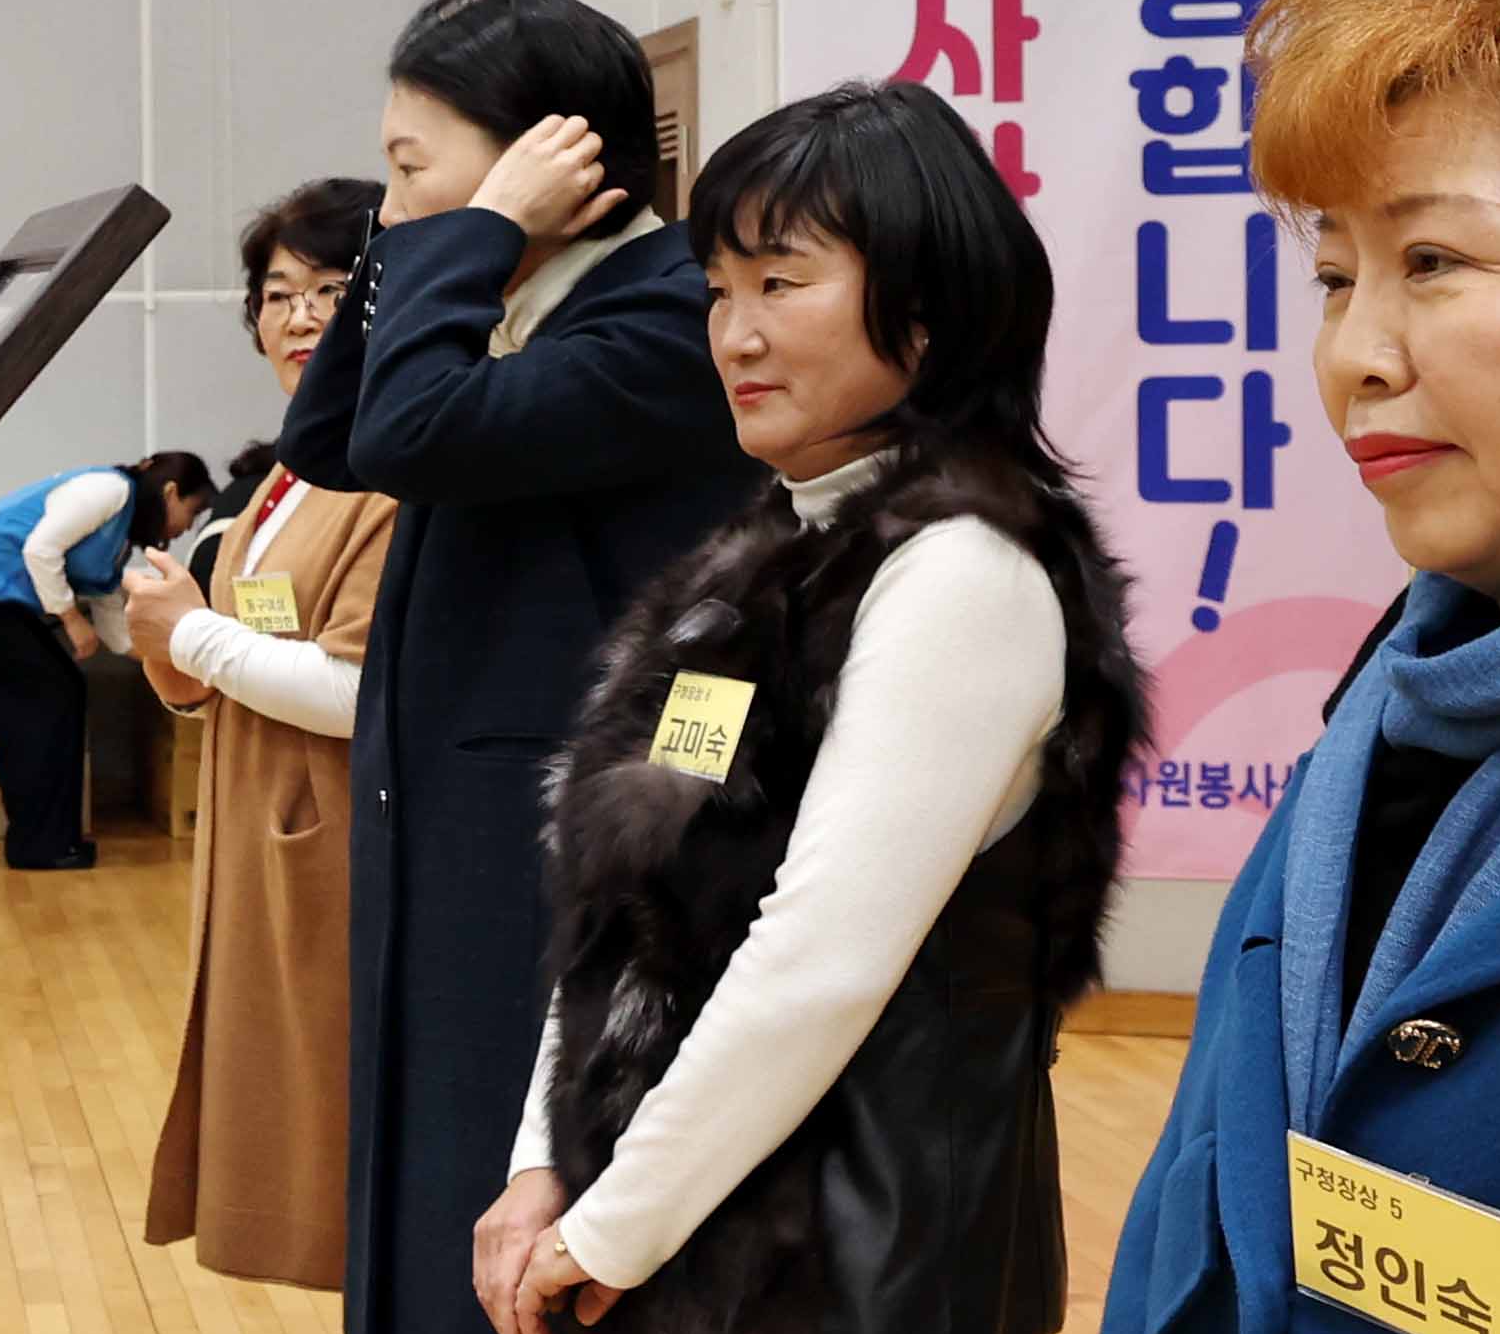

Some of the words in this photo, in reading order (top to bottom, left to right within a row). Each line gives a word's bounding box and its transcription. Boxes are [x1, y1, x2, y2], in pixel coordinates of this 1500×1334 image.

[660, 717, 728, 763] 고미숙
[1295, 1157, 1379, 1211] 구청장상
[1389, 1197, 1403, 1220] 5
